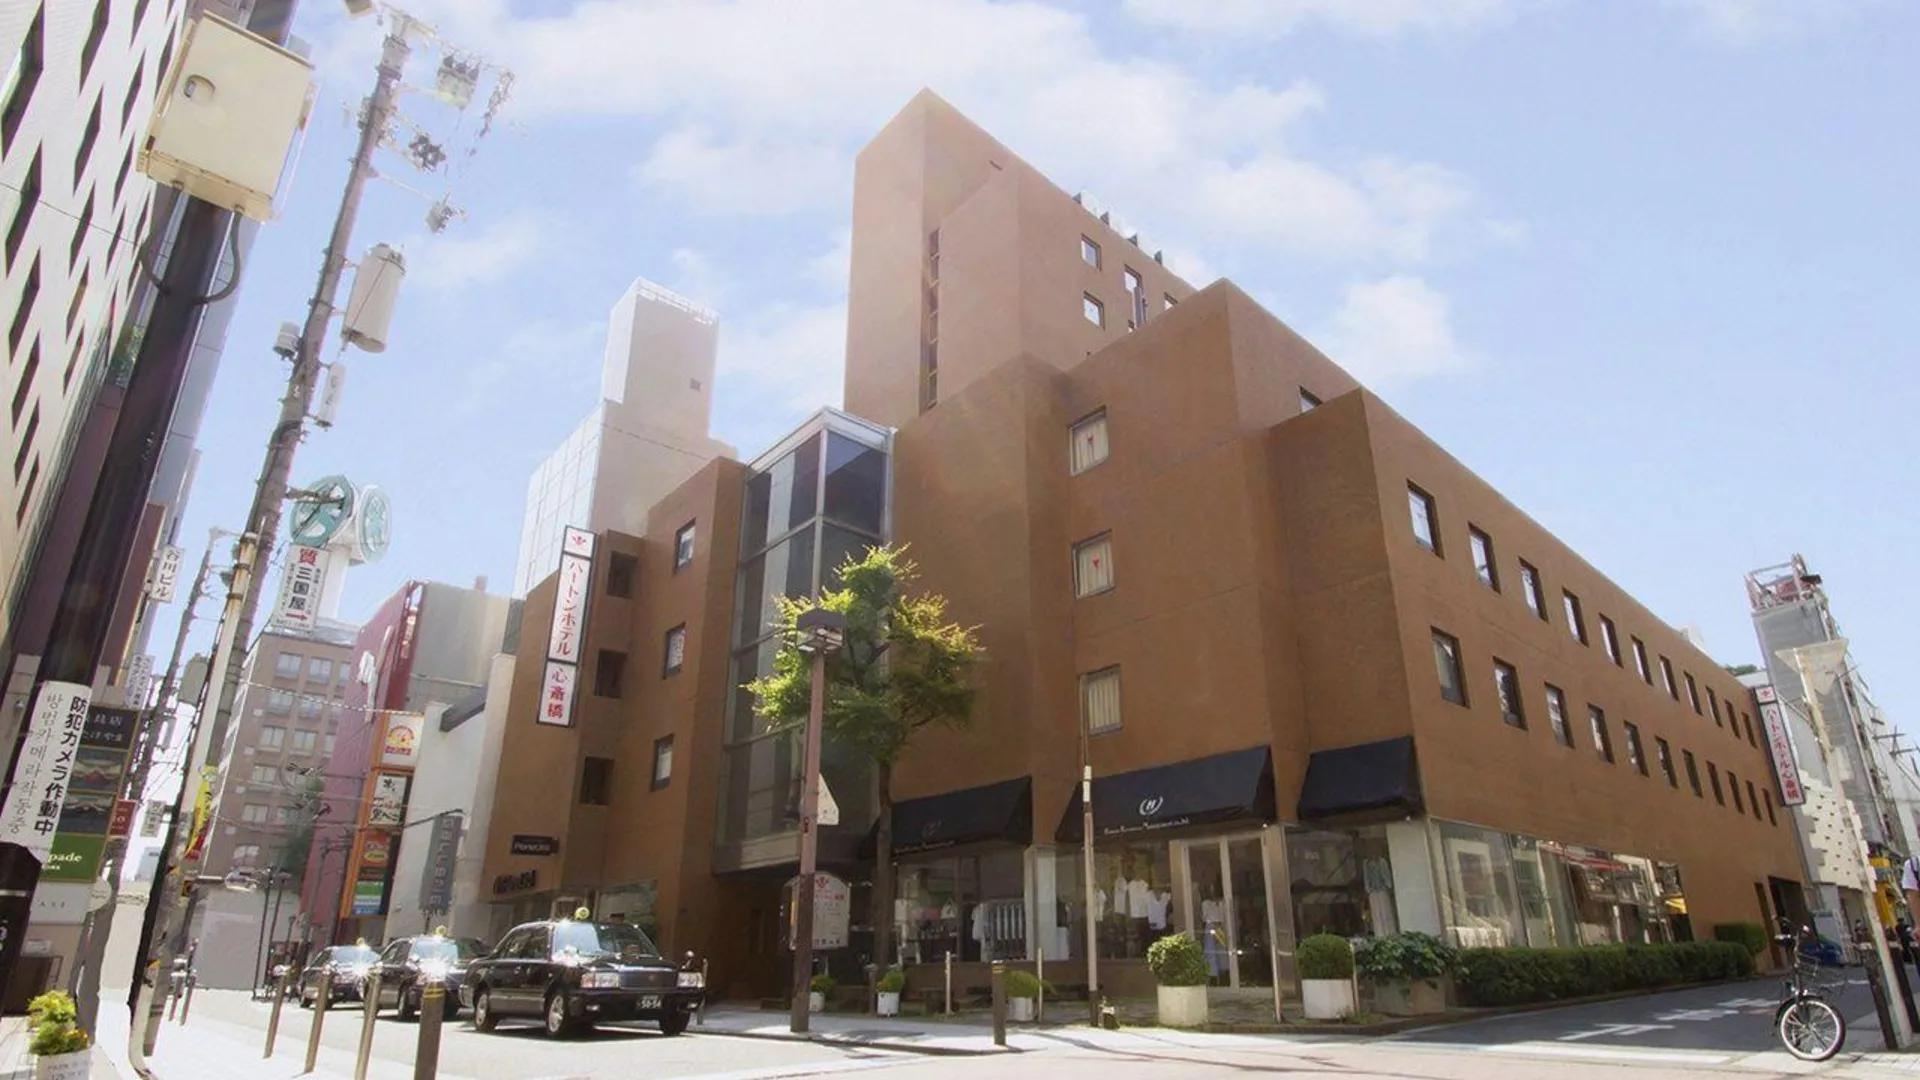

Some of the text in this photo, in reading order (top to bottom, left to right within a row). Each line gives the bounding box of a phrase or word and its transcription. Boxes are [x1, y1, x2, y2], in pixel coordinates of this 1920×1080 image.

[556, 561, 583, 656] ハートンホテル
[546, 667, 568, 719] 心斎橋
[34, 695, 88, 837] 防犯カメラ作動中
